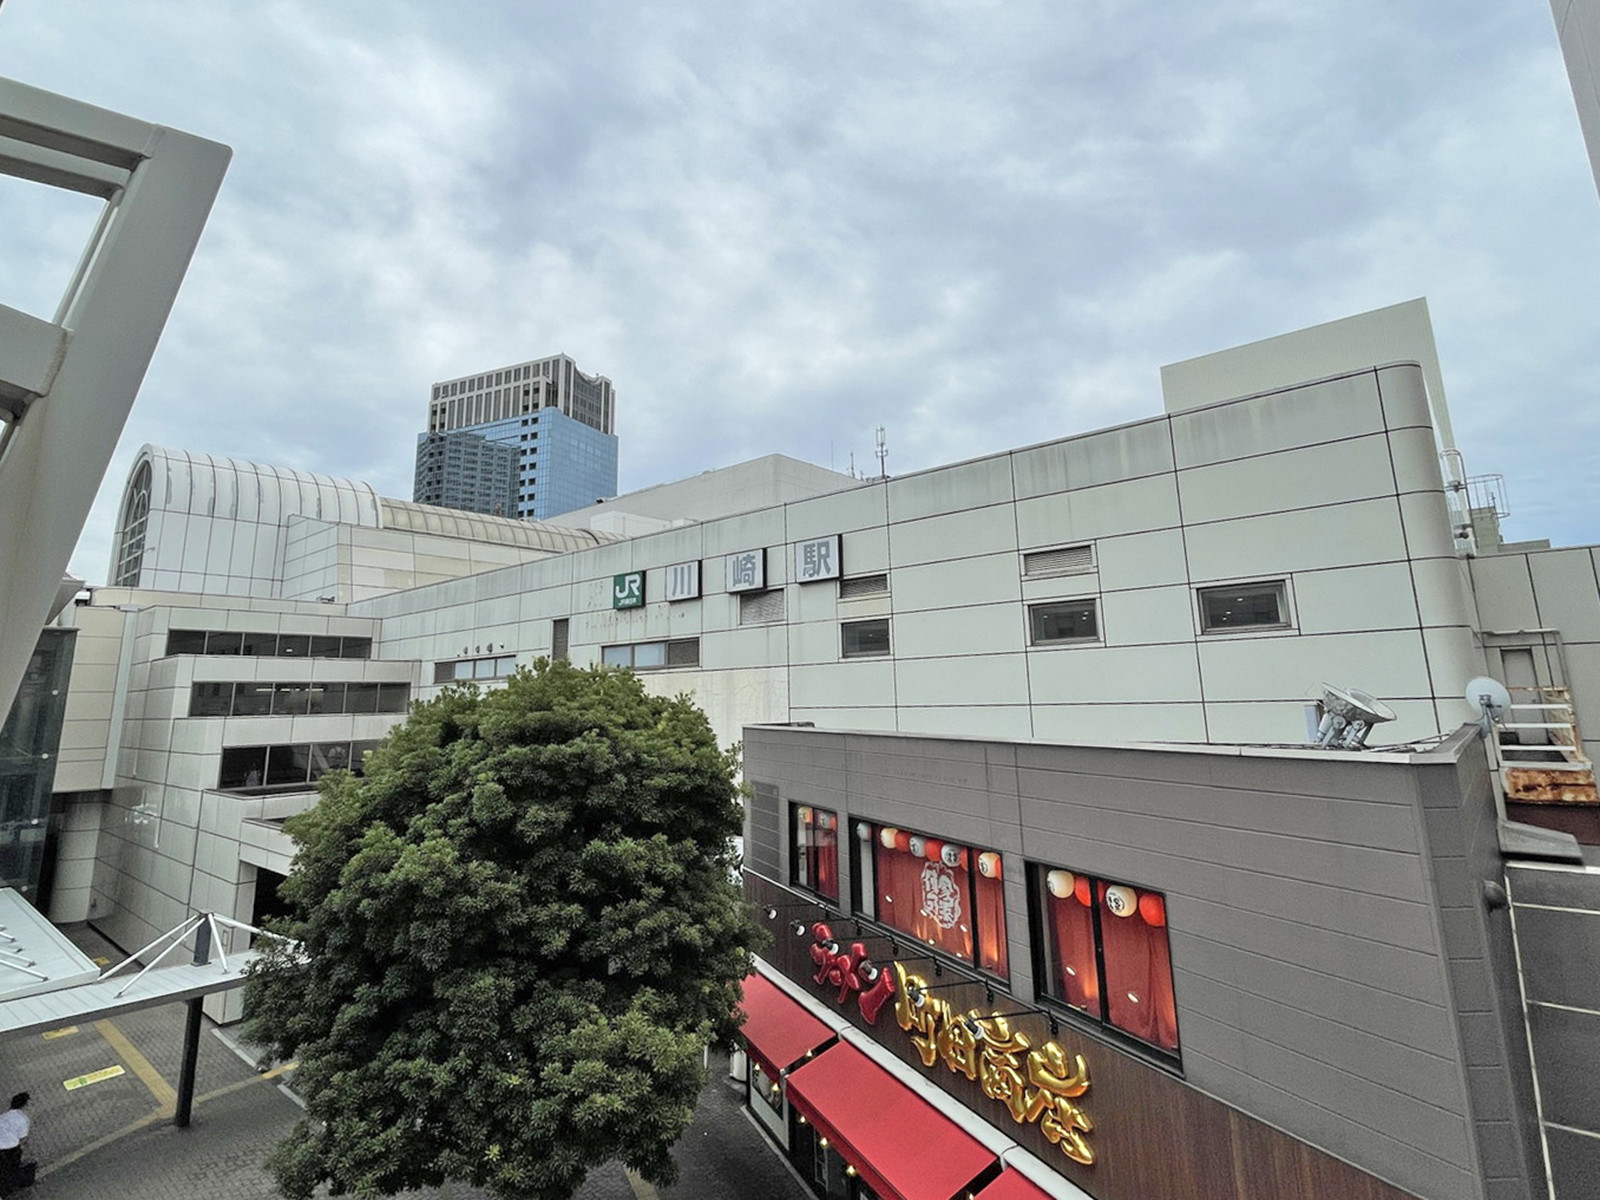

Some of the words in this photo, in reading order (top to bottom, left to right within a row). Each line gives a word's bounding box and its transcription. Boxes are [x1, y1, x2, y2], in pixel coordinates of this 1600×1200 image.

[615, 574, 641, 598] JR
[672, 541, 831, 597] 川崎駅
